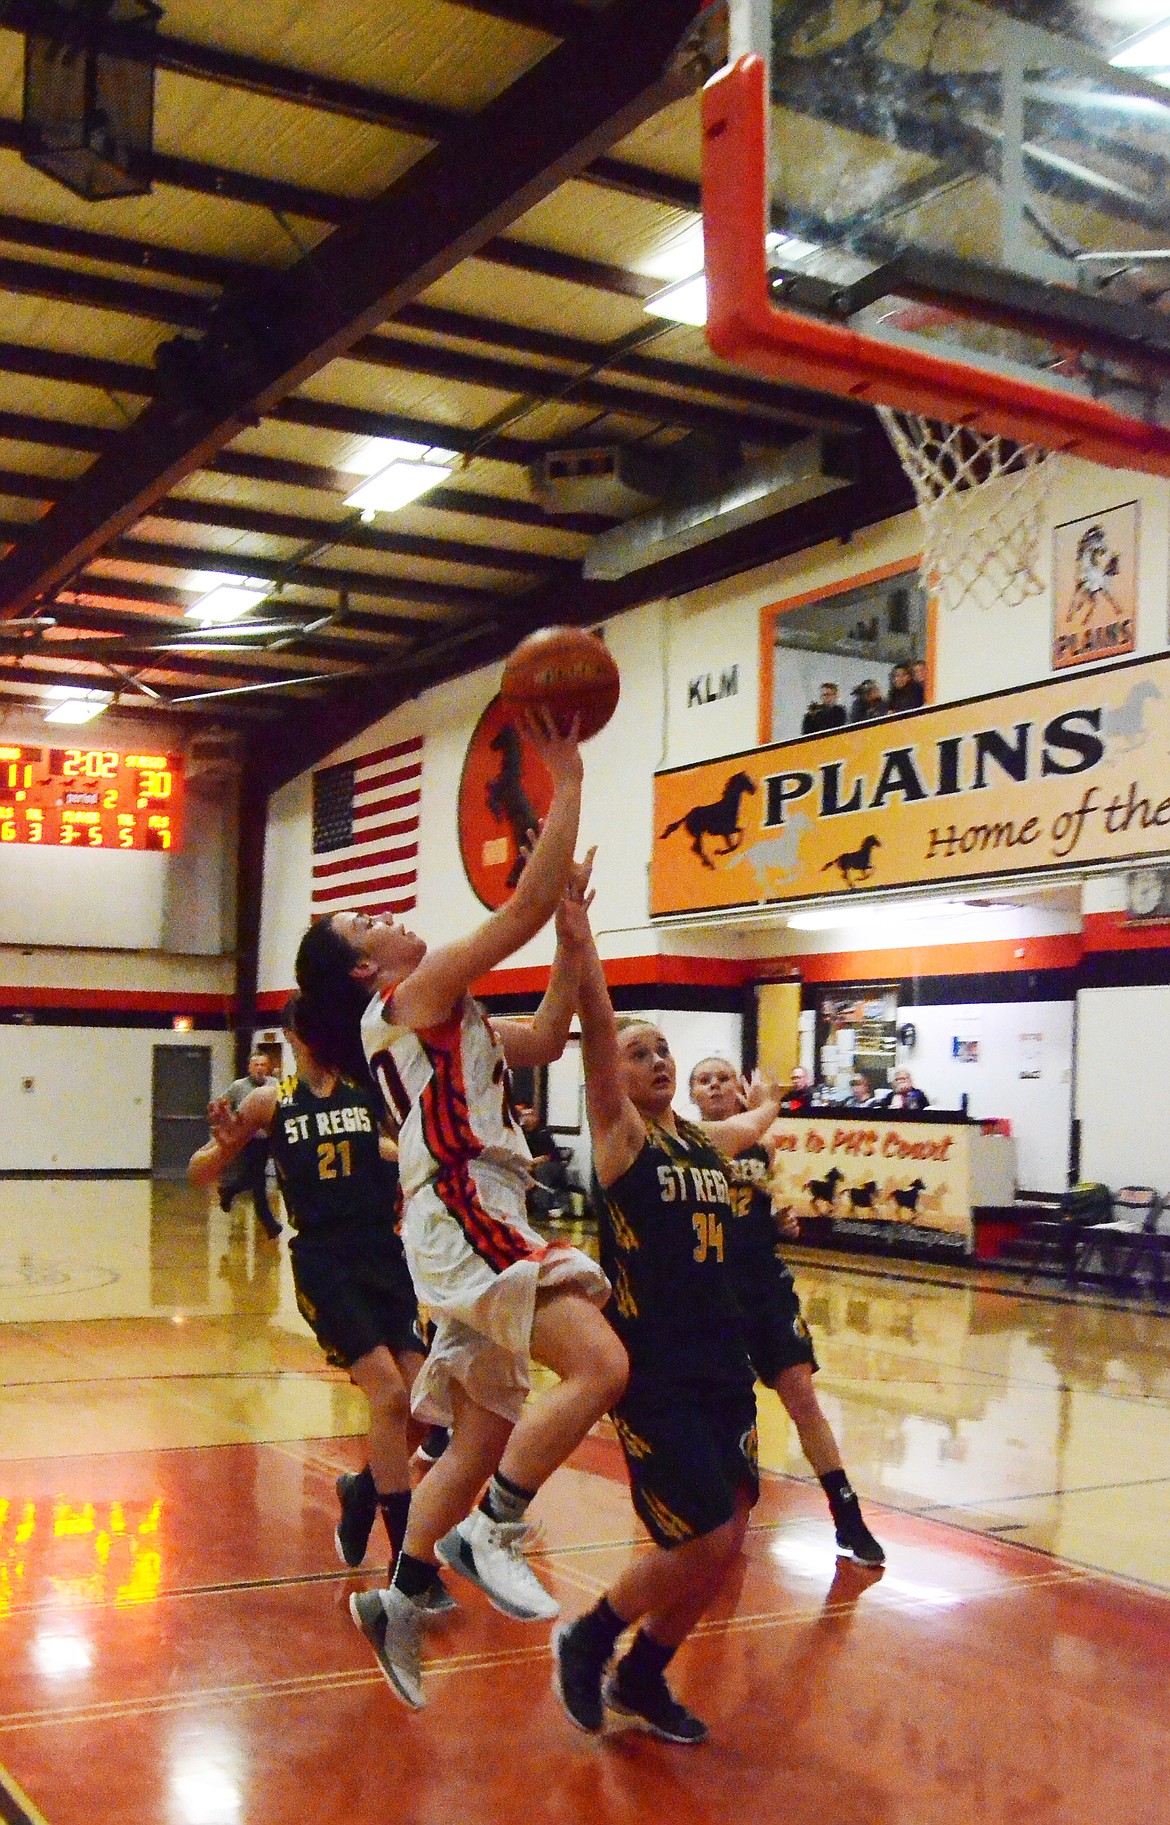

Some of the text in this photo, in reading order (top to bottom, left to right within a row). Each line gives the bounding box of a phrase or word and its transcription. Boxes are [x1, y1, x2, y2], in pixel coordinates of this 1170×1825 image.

[1052, 619, 1134, 661] PLAINS
[687, 664, 739, 708] KLM
[63, 750, 119, 778] 2:02
[764, 707, 1105, 827] PLAINS
[103, 789, 119, 809] 2
[139, 771, 172, 798] 30
[28, 822, 42, 843] 3
[119, 828, 134, 847] 5
[925, 781, 1170, 859] Home of the
[284, 1106, 372, 1144] ST REGIS
[317, 1140, 352, 1180] 21
[657, 1165, 688, 1202] ST
[690, 1167, 731, 1206] REGI
[692, 1212, 724, 1263] 34
